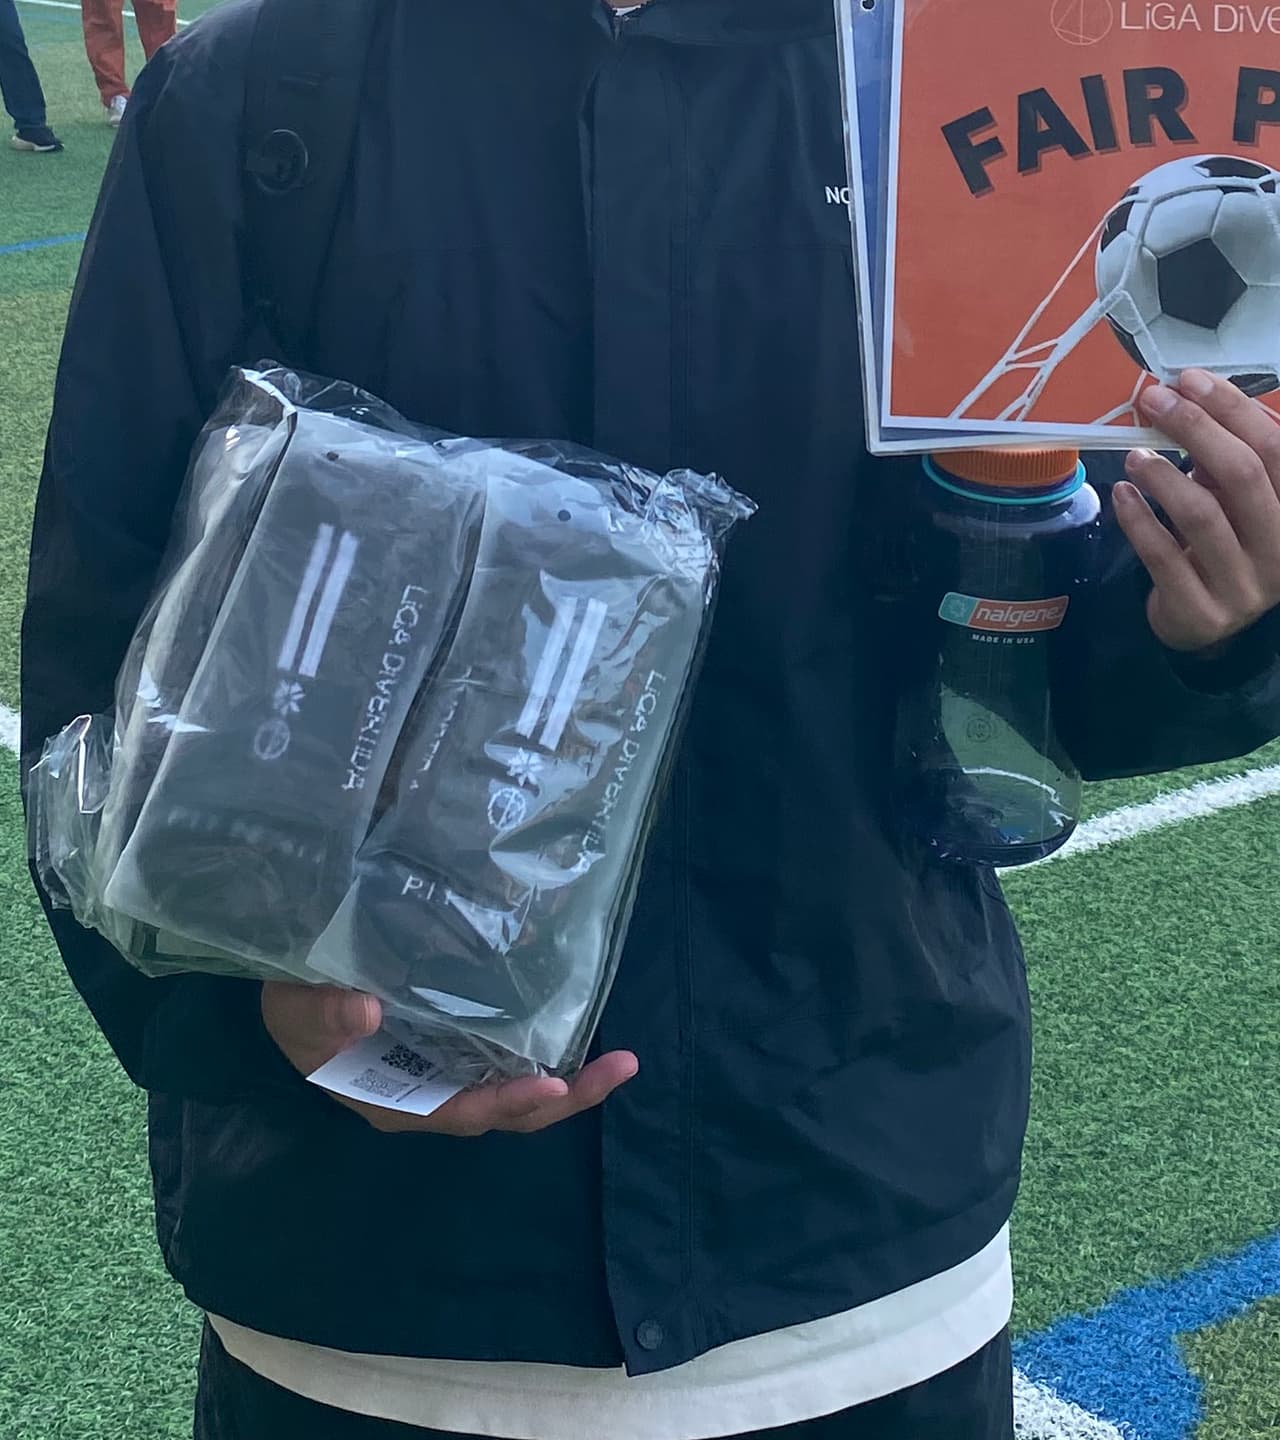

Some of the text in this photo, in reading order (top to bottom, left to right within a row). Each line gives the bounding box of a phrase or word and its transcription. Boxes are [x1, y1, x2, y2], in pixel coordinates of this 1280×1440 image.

[940, 66, 1196, 197] FAIR
[975, 605, 1060, 628] nalgene
[972, 633, 998, 644] MADE
[1016, 636, 1035, 644] USA
